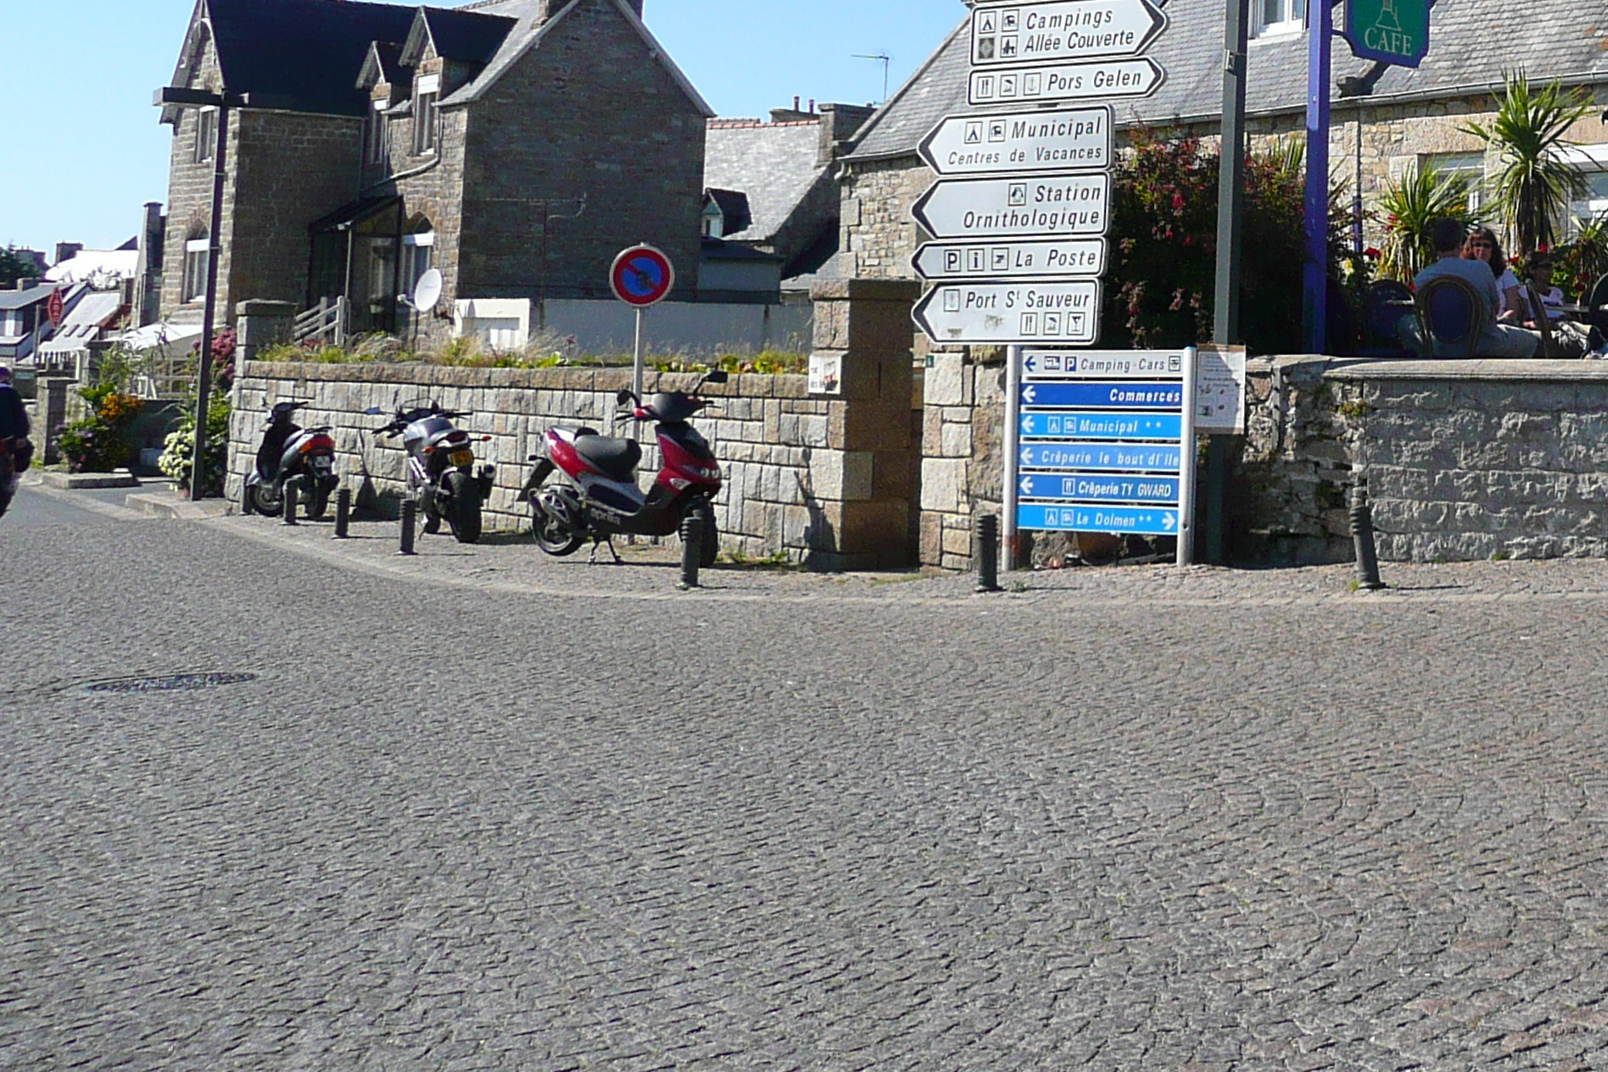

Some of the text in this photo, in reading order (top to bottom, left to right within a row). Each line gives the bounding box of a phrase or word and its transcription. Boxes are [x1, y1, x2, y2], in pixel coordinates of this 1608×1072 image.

[1026, 9, 1113, 31] Campings
[1024, 31, 1134, 53] Allée Couverte
[1364, 27, 1412, 57] CAFE
[1047, 69, 1142, 91] Pors Gelen
[1011, 116, 1102, 141] Municipal
[948, 146, 1102, 166] Centres de Vacances
[1035, 183, 1101, 203] Station
[963, 208, 1100, 230] Ornithologique
[1015, 250, 1033, 268] La
[1047, 249, 1096, 267] Poste
[965, 291, 996, 309] Port
[1025, 290, 1090, 308] Sauveur
[1109, 388, 1180, 402] Commerces
[1079, 419, 1138, 435] Municipal
[1099, 451, 1110, 464] le
[1117, 452, 1143, 465] bout
[1121, 483, 1133, 495] TY
[1137, 484, 1171, 497] GWARD
[1076, 512, 1135, 527] Le Dolmen
